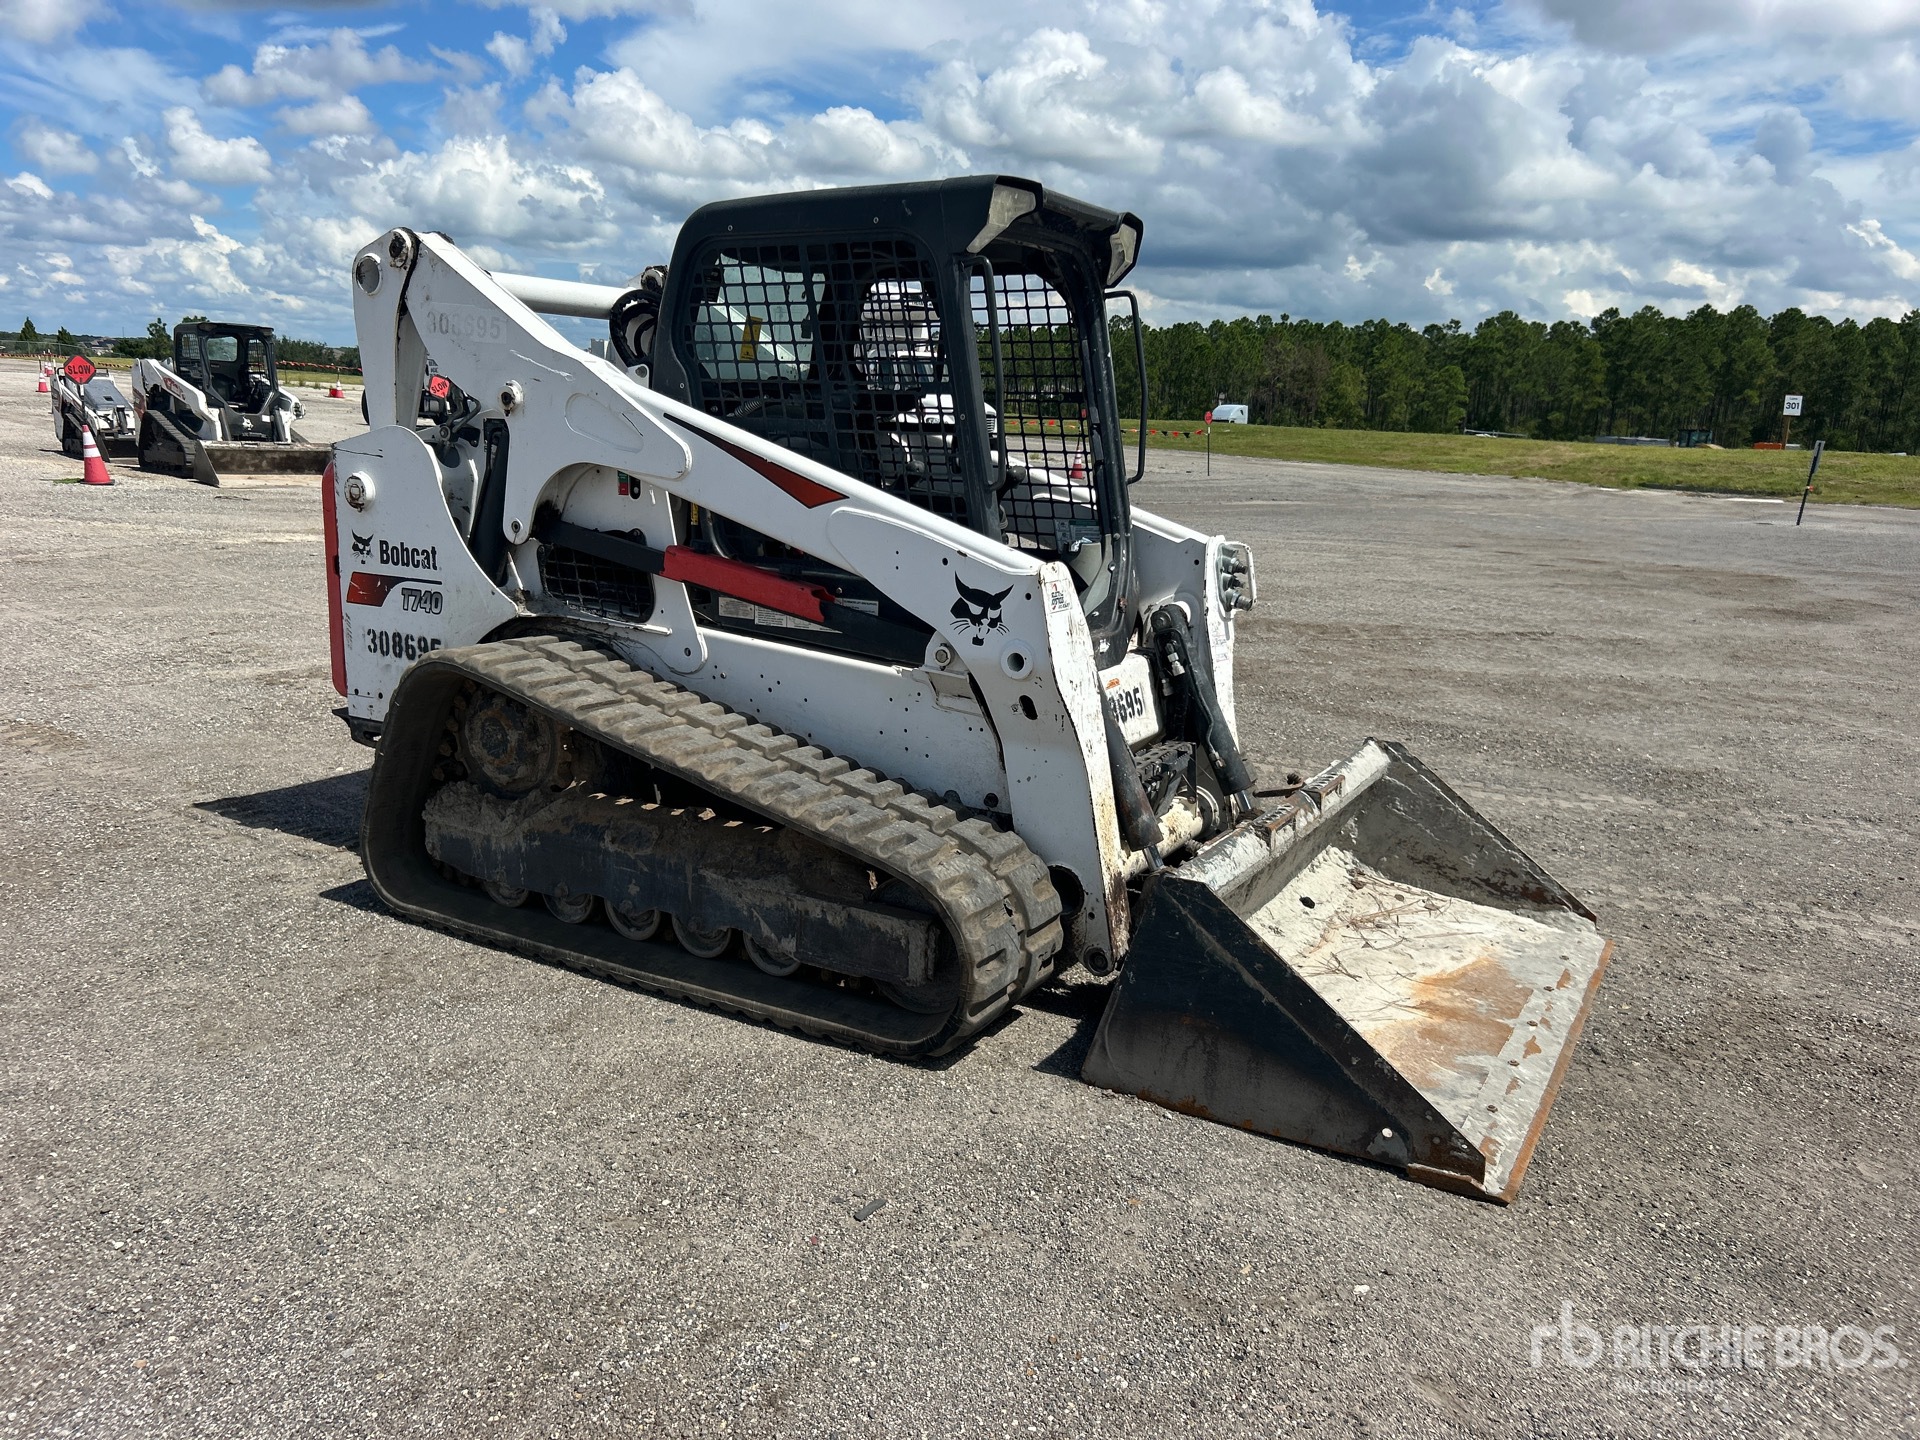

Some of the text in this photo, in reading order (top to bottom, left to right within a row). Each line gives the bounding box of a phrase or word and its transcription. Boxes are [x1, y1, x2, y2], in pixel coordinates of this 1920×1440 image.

[67, 365, 91, 374] SLOW
[431, 380, 448, 394] SLOW
[1786, 402, 1799, 410] 301
[379, 540, 438, 570] Bobcat
[401, 587, 444, 615] T740
